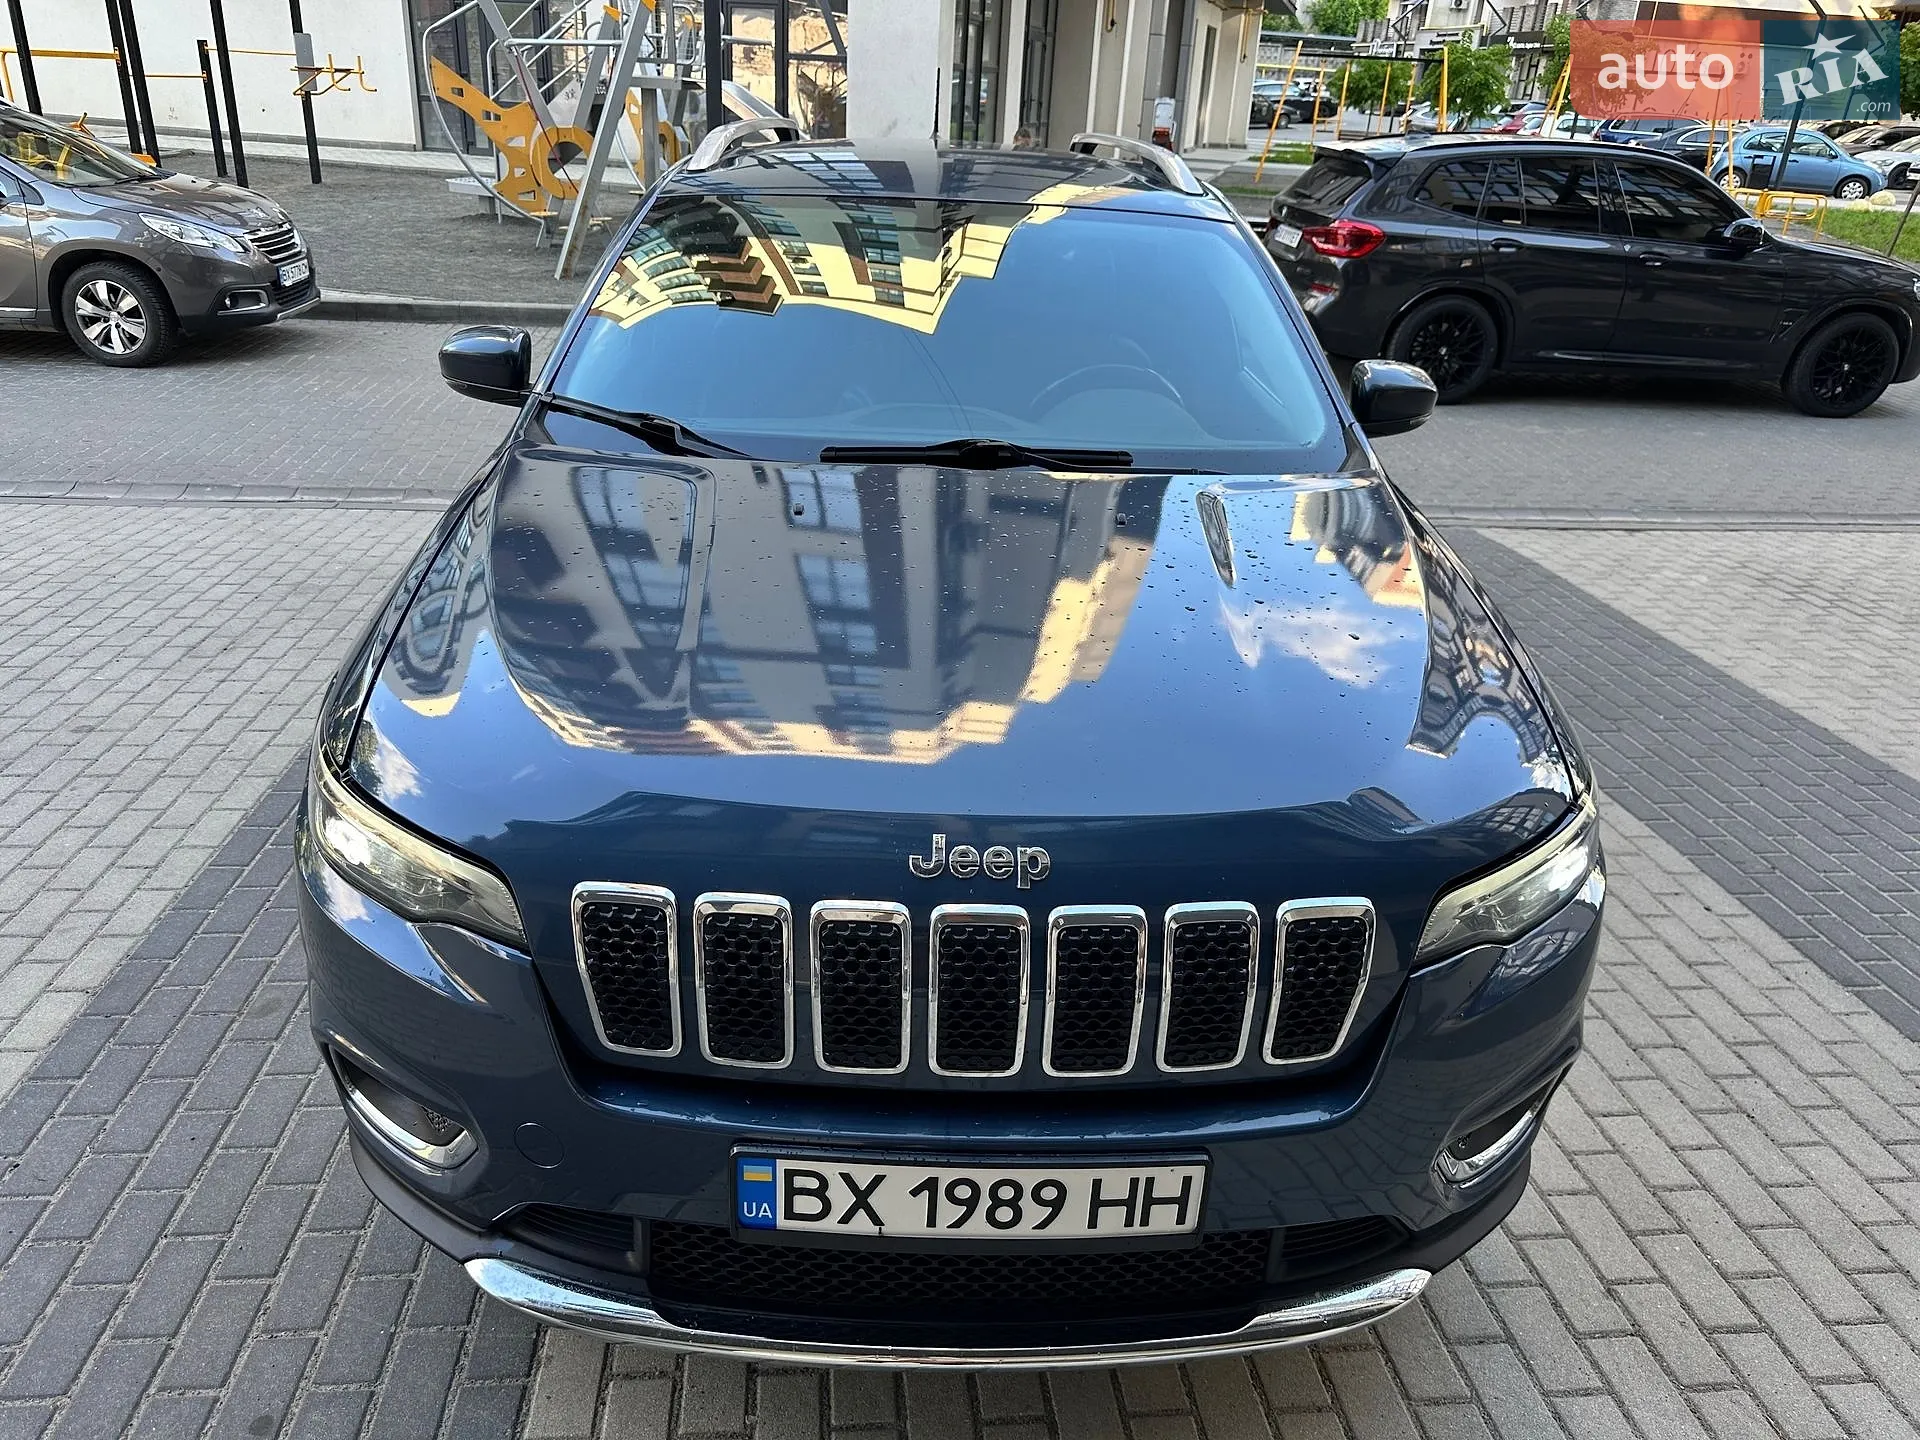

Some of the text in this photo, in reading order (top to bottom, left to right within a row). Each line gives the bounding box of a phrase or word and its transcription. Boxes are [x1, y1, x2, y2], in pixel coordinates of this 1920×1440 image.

[909, 833, 1051, 890] Jeep
[744, 1201, 773, 1219] UA
[783, 1168, 1193, 1230] BX 1989 HH
